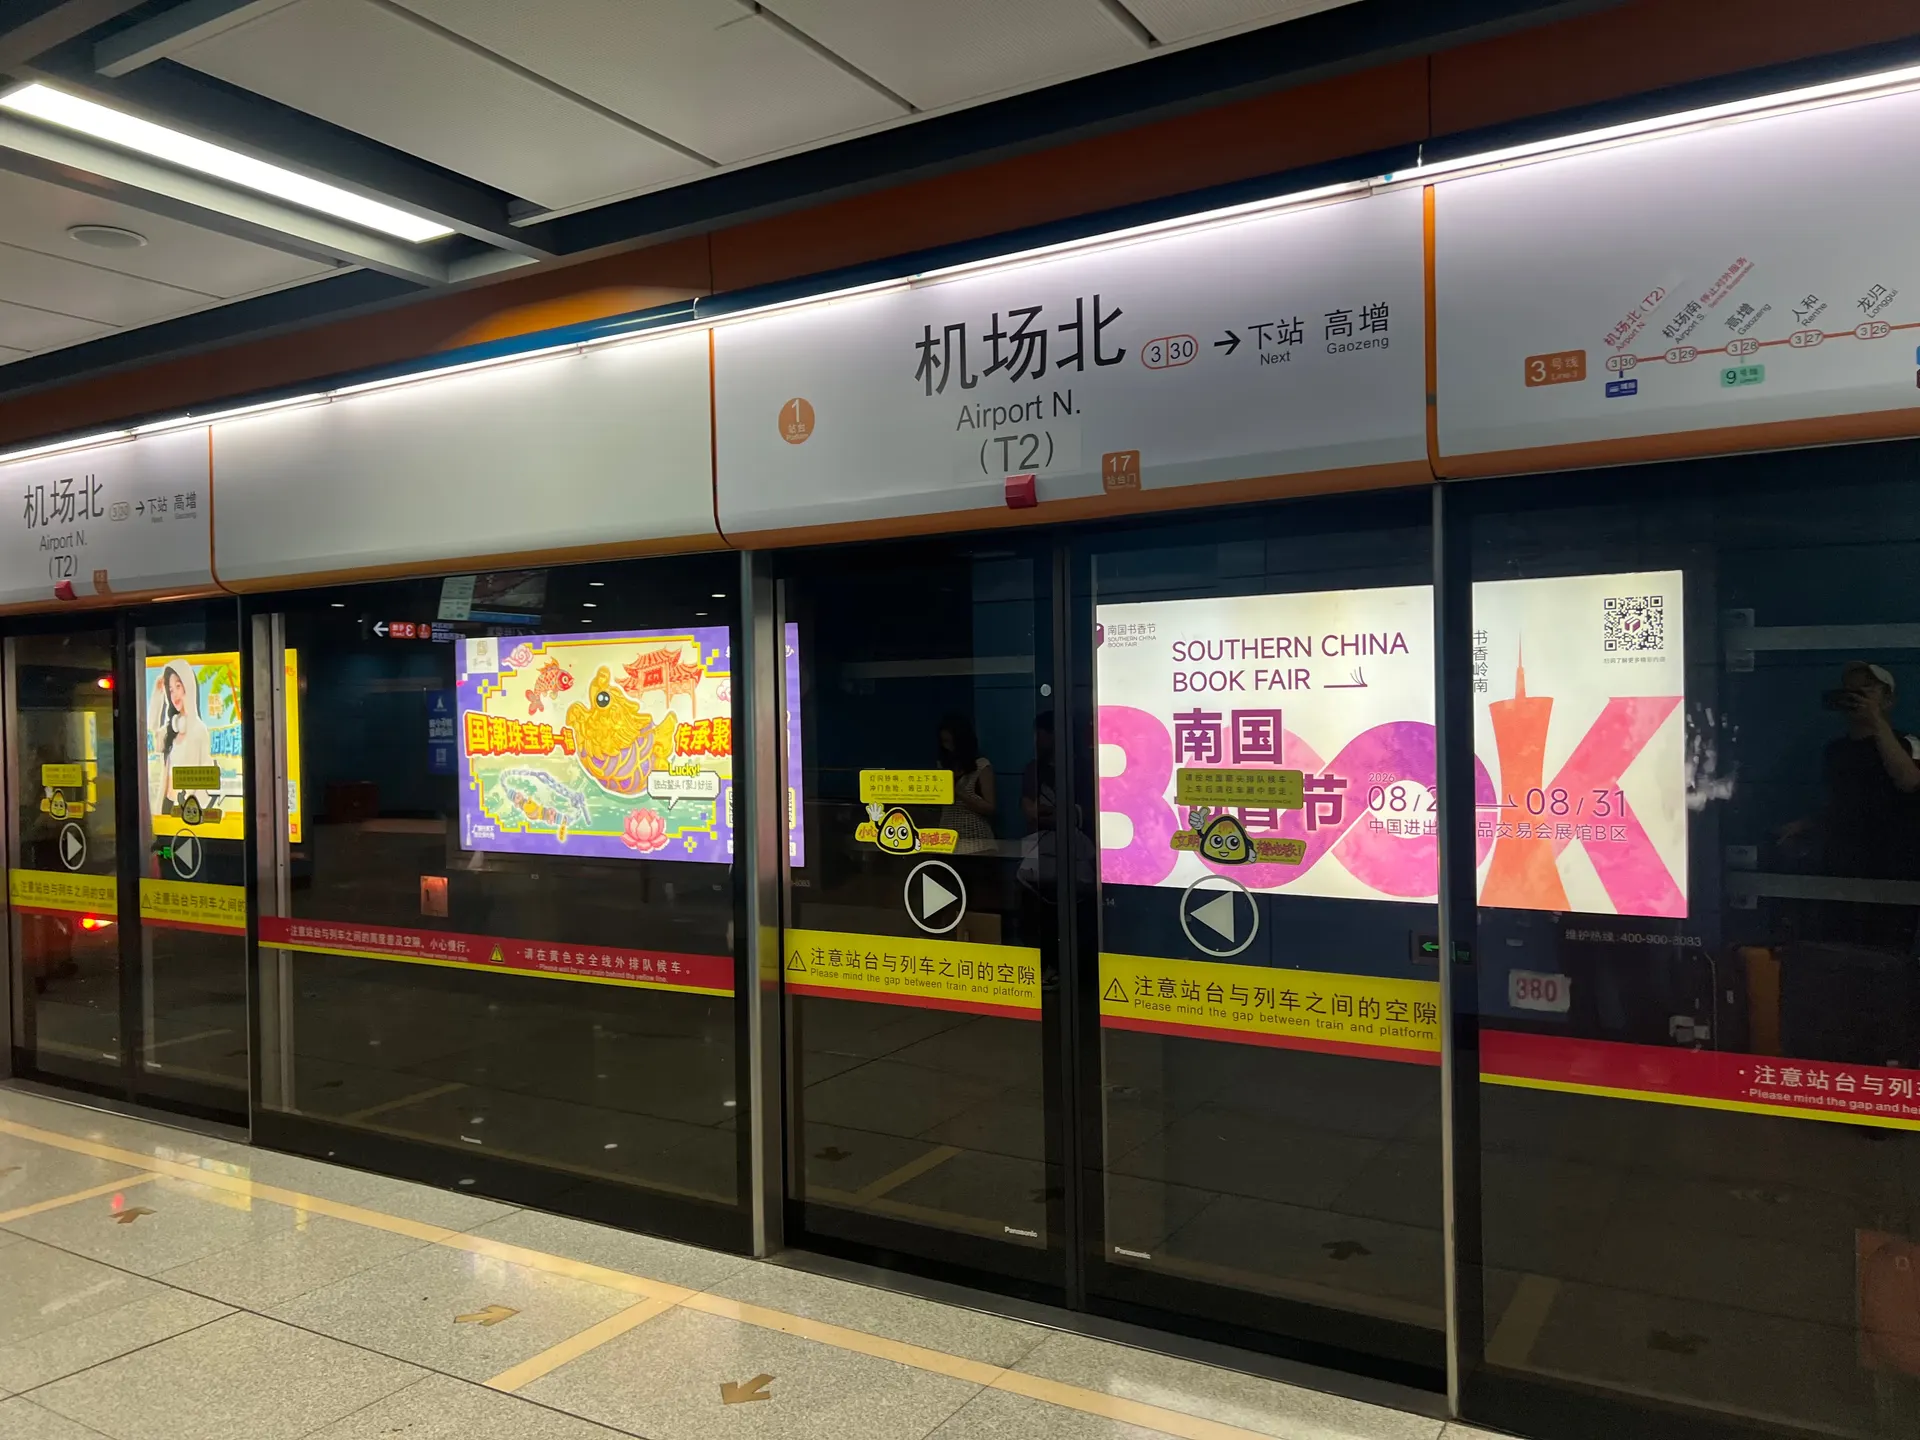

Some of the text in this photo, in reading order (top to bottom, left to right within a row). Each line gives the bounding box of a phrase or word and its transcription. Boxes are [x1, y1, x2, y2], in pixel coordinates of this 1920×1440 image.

[1791, 293, 1820, 323] 人和
[1856, 283, 1888, 314] 龙归
[1866, 287, 1899, 319] Longgui
[1248, 302, 1389, 351] 下站 高增
[1603, 286, 1666, 347] 机场北 (T2)
[1662, 300, 1702, 338] 机场南
[1724, 302, 1755, 331] 高增
[1737, 303, 1772, 336] Gaozeng
[1801, 302, 1829, 327] Renhe
[1675, 319, 1699, 345] Airport
[1795, 334, 1821, 344] 3 27
[1860, 325, 1887, 336] 3 26
[914, 294, 1126, 397] 机场北
[1150, 340, 1194, 363] 3 30
[1260, 350, 1291, 366] Next
[1326, 336, 1389, 355] Gaozeng
[1670, 348, 1695, 360] 3 29
[1731, 341, 1757, 353] 3 28
[1530, 360, 1546, 382] 3
[1551, 356, 1579, 370] 号线
[1611, 357, 1634, 368] 3 30
[1726, 370, 1737, 384] 9
[791, 399, 800, 422] 1
[956, 389, 1082, 431] Airport N.
[788, 423, 806, 434] 站台
[979, 431, 1055, 475] (T2)
[1109, 455, 1132, 473] 17
[1106, 473, 1137, 486] 站台门
[23, 474, 104, 529] 机场北
[147, 491, 197, 513] 下站 高增
[39, 530, 88, 551] Airport N.
[49, 555, 78, 579] (T2)
[1107, 623, 1157, 636] 南国书香节
[1172, 632, 1410, 663] SOUTHERN CHINA
[1473, 629, 1488, 693] 书香岭南
[1172, 668, 1311, 693] BOOK FAIR
[1172, 708, 1283, 765] 南国
[669, 763, 701, 778] Lucky!
[1368, 773, 1395, 783] 2026
[1368, 785, 1437, 812] 08/2
[858, 826, 878, 839] 小心
[20, 881, 115, 901] 注意站台与列车之间的空隙
[539, 963, 558, 972] Please
[810, 947, 1036, 986] 注意站台与列车之间的空隙
[810, 968, 1036, 999] Please mind the gap between train and platform.
[1516, 978, 1558, 1003] 380
[1134, 975, 1438, 1026] 注意站台与列车之间的空隙
[1134, 999, 1437, 1040] Please mind the gap between train and platform.
[1754, 1064, 1920, 1099] 注意站台与列
[1749, 1088, 1791, 1101] Please
[1794, 1092, 1823, 1105] mind
[1826, 1095, 1846, 1107] the
[1849, 1100, 1873, 1111] gap
[1875, 1101, 1899, 1113] and
